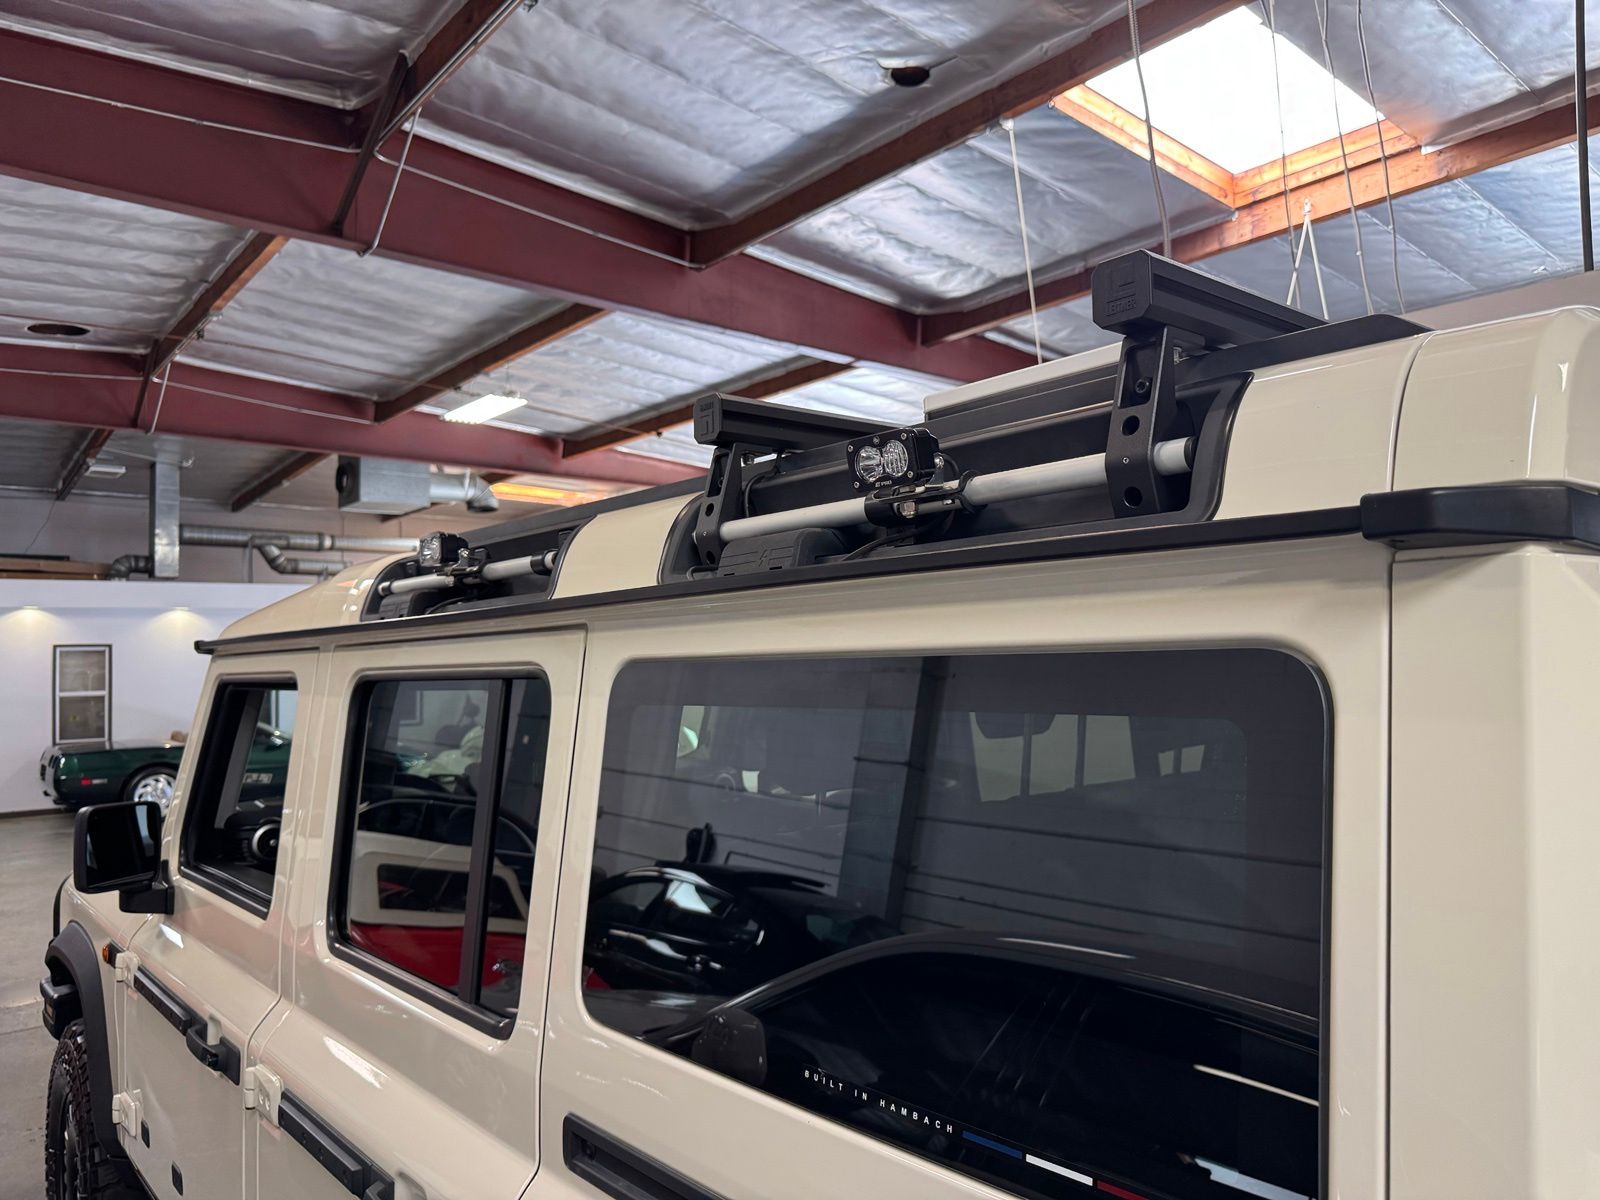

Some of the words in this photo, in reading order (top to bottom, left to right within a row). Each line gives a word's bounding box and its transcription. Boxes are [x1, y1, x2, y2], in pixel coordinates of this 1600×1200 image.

[804, 1070, 843, 1091] BUILT
[854, 1089, 867, 1101] IN
[879, 1099, 953, 1134] HAMBACH
